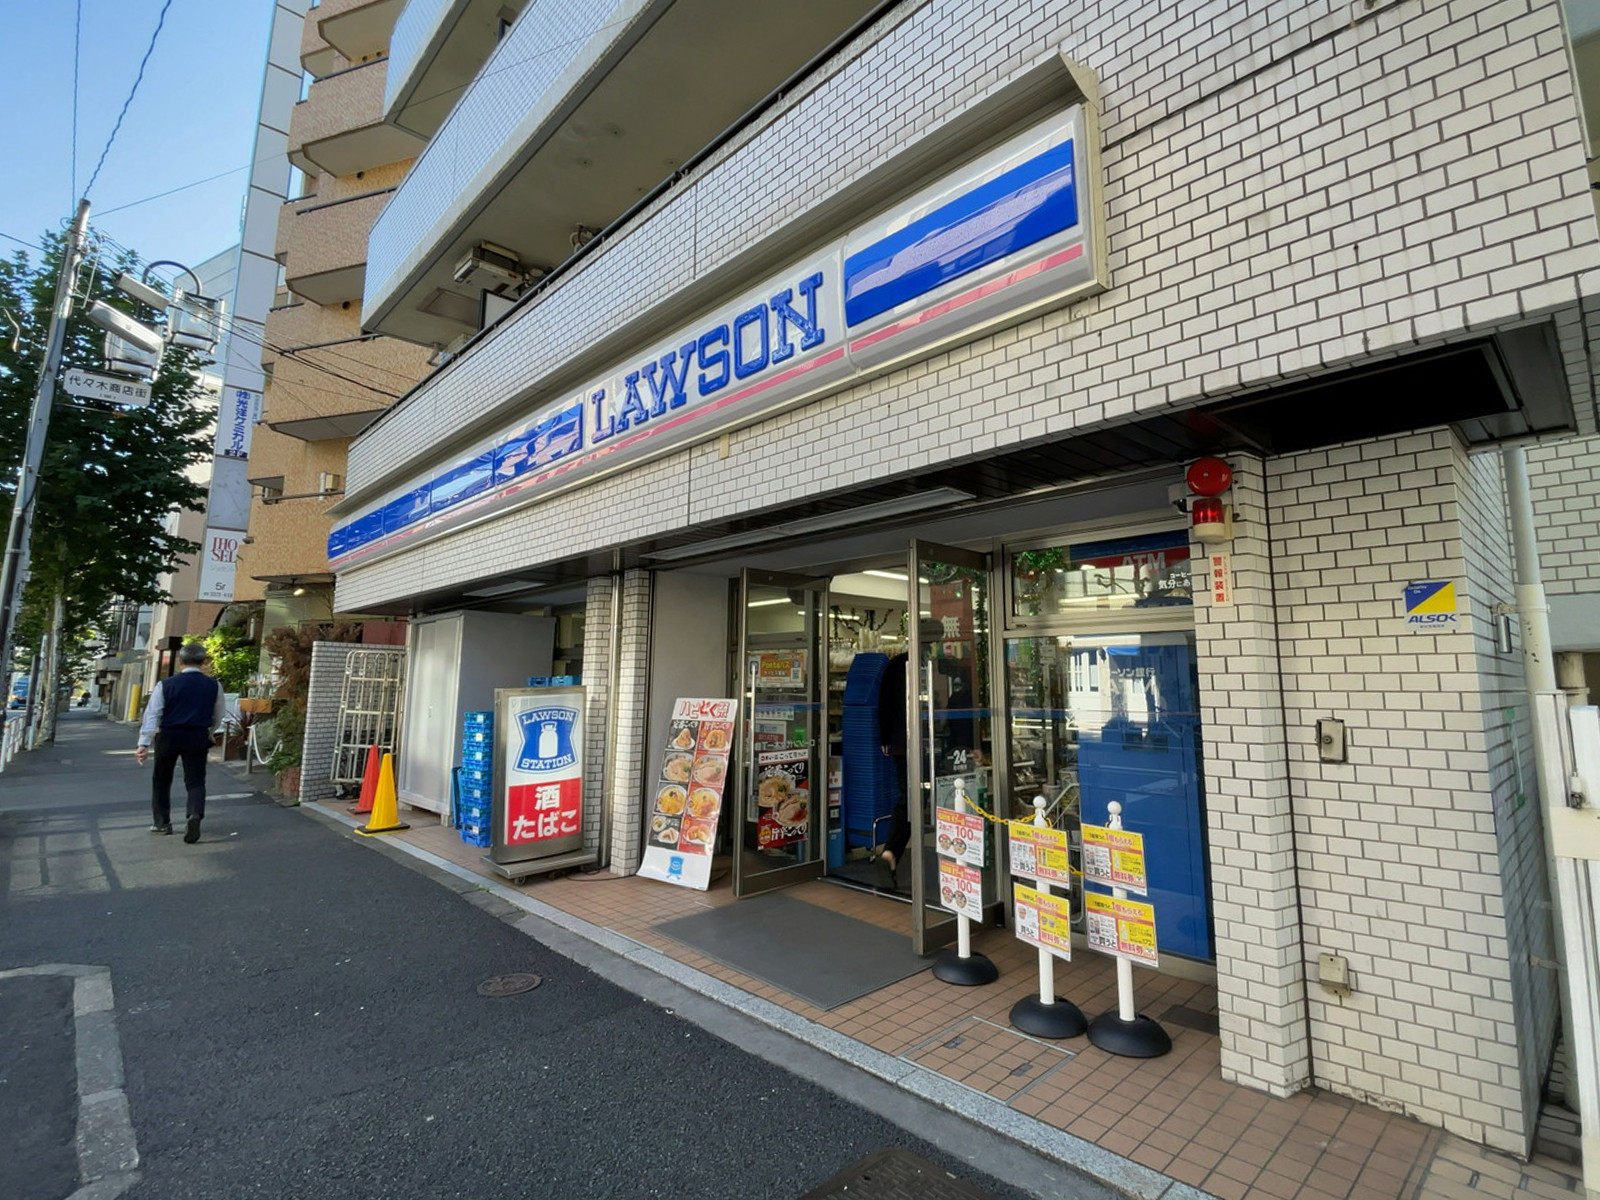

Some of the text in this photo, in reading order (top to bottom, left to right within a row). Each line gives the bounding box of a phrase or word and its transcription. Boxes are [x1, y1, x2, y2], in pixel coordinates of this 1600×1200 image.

[592, 271, 824, 444] LAWSON
[69, 375, 147, 398] 代々木商店街
[1408, 613, 1457, 624] ALSOK
[1111, 667, 1156, 678] ーソン銀行
[521, 710, 574, 725] LAWSON
[520, 753, 573, 769] STATION
[534, 783, 561, 811] 酒
[512, 809, 577, 840] たばこ
[955, 825, 974, 841] 100
[956, 878, 973, 893] 100
